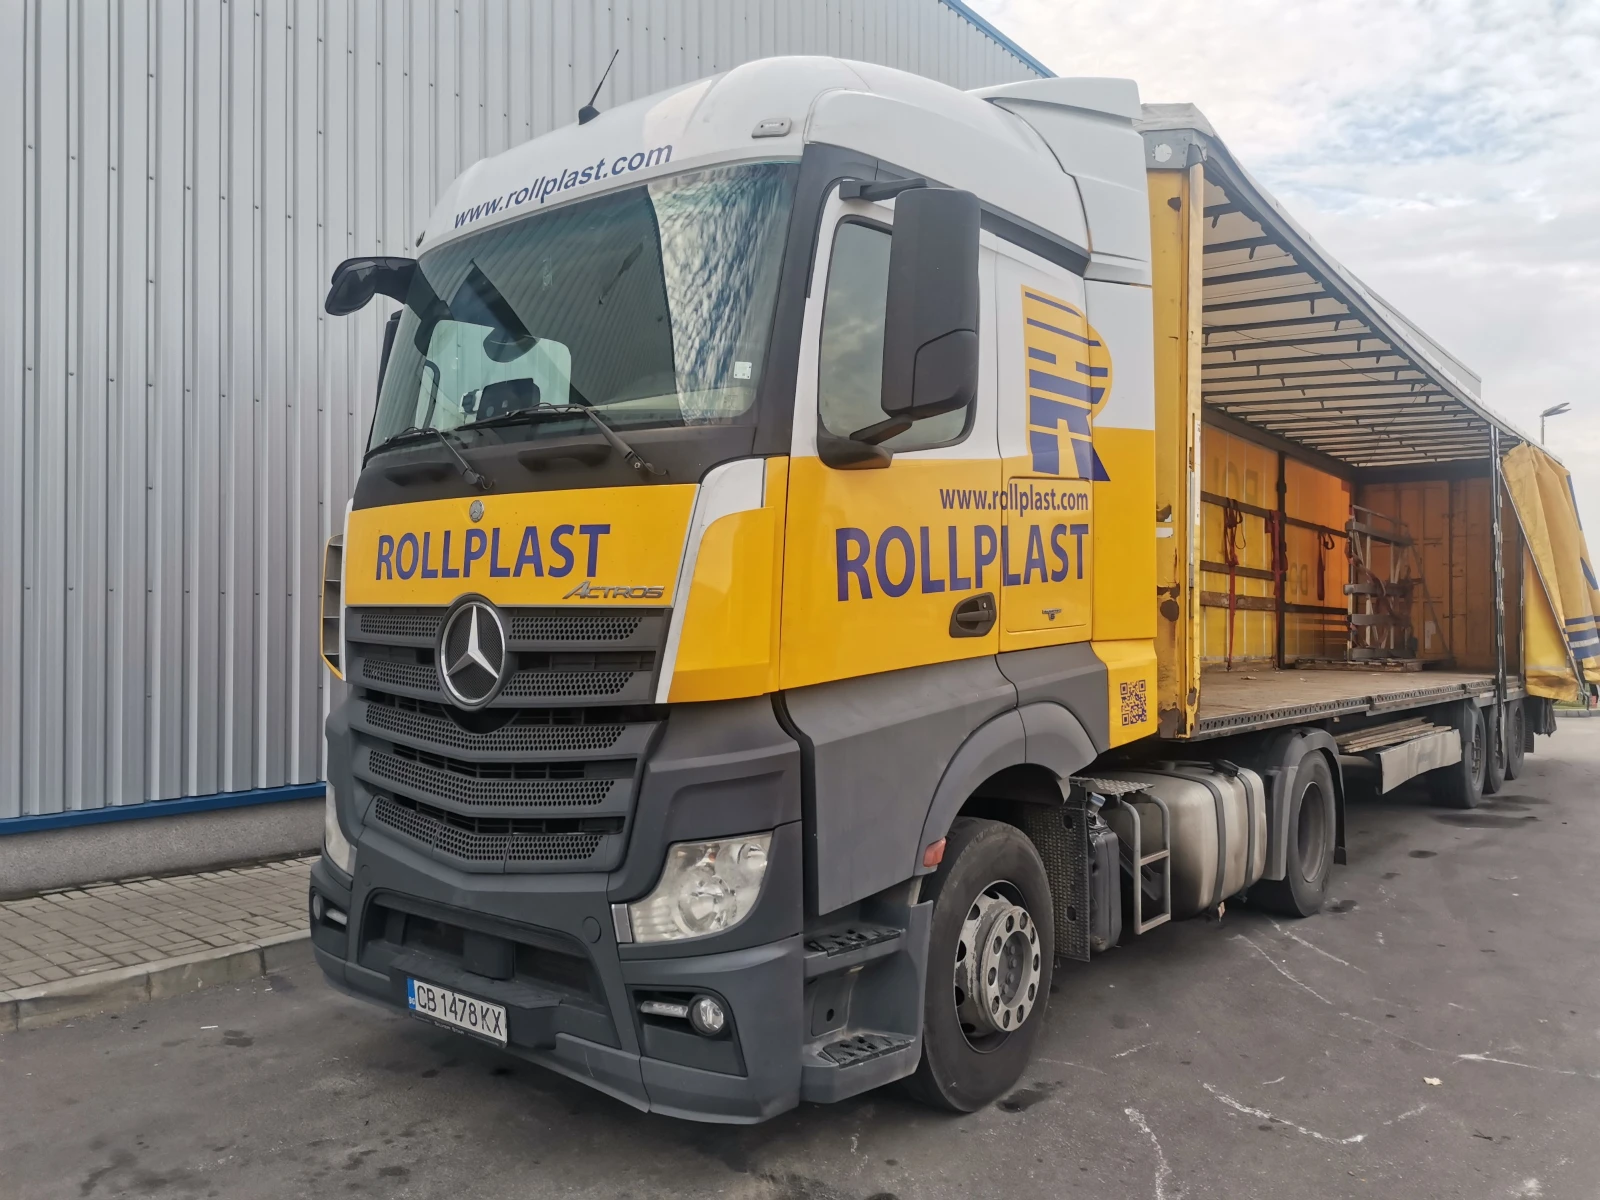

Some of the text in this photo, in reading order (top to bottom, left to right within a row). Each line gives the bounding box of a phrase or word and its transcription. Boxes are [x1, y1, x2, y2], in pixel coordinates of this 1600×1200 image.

[454, 144, 673, 229] www.rollplast.com
[939, 482, 1089, 518] www.rollplast.com
[375, 523, 611, 581] ROLLPLAST
[835, 523, 1089, 602] ROLLPLAST
[441, 993, 478, 1026] 1478
